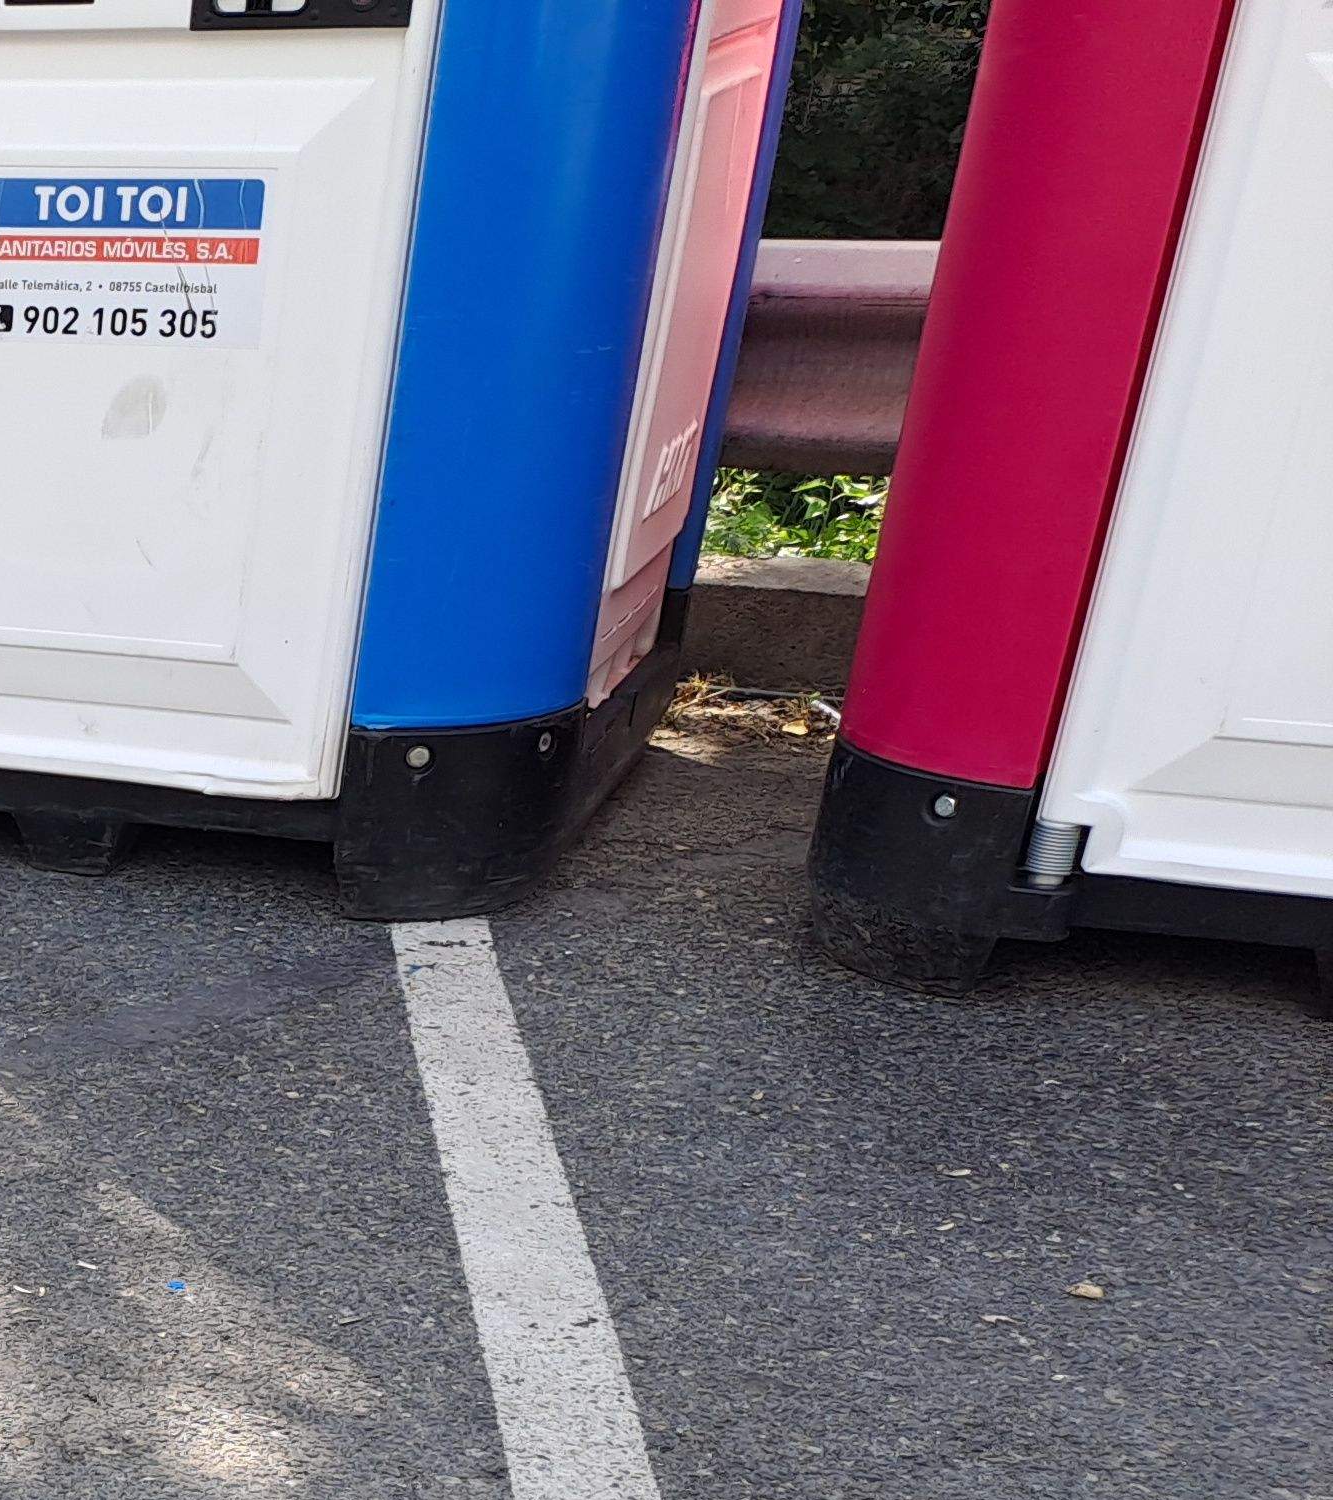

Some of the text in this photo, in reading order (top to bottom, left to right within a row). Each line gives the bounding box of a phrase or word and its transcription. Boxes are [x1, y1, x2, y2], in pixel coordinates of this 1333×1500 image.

[34, 185, 188, 223] TOI TOI
[103, 237, 189, 260] MÓVILES,
[196, 242, 233, 260] S.A.
[22, 279, 83, 292] Telemática,
[85, 281, 93, 291] 2
[109, 281, 142, 292] 08755
[144, 281, 218, 294] Castellbisbal
[23, 305, 219, 339] 902 105 305
